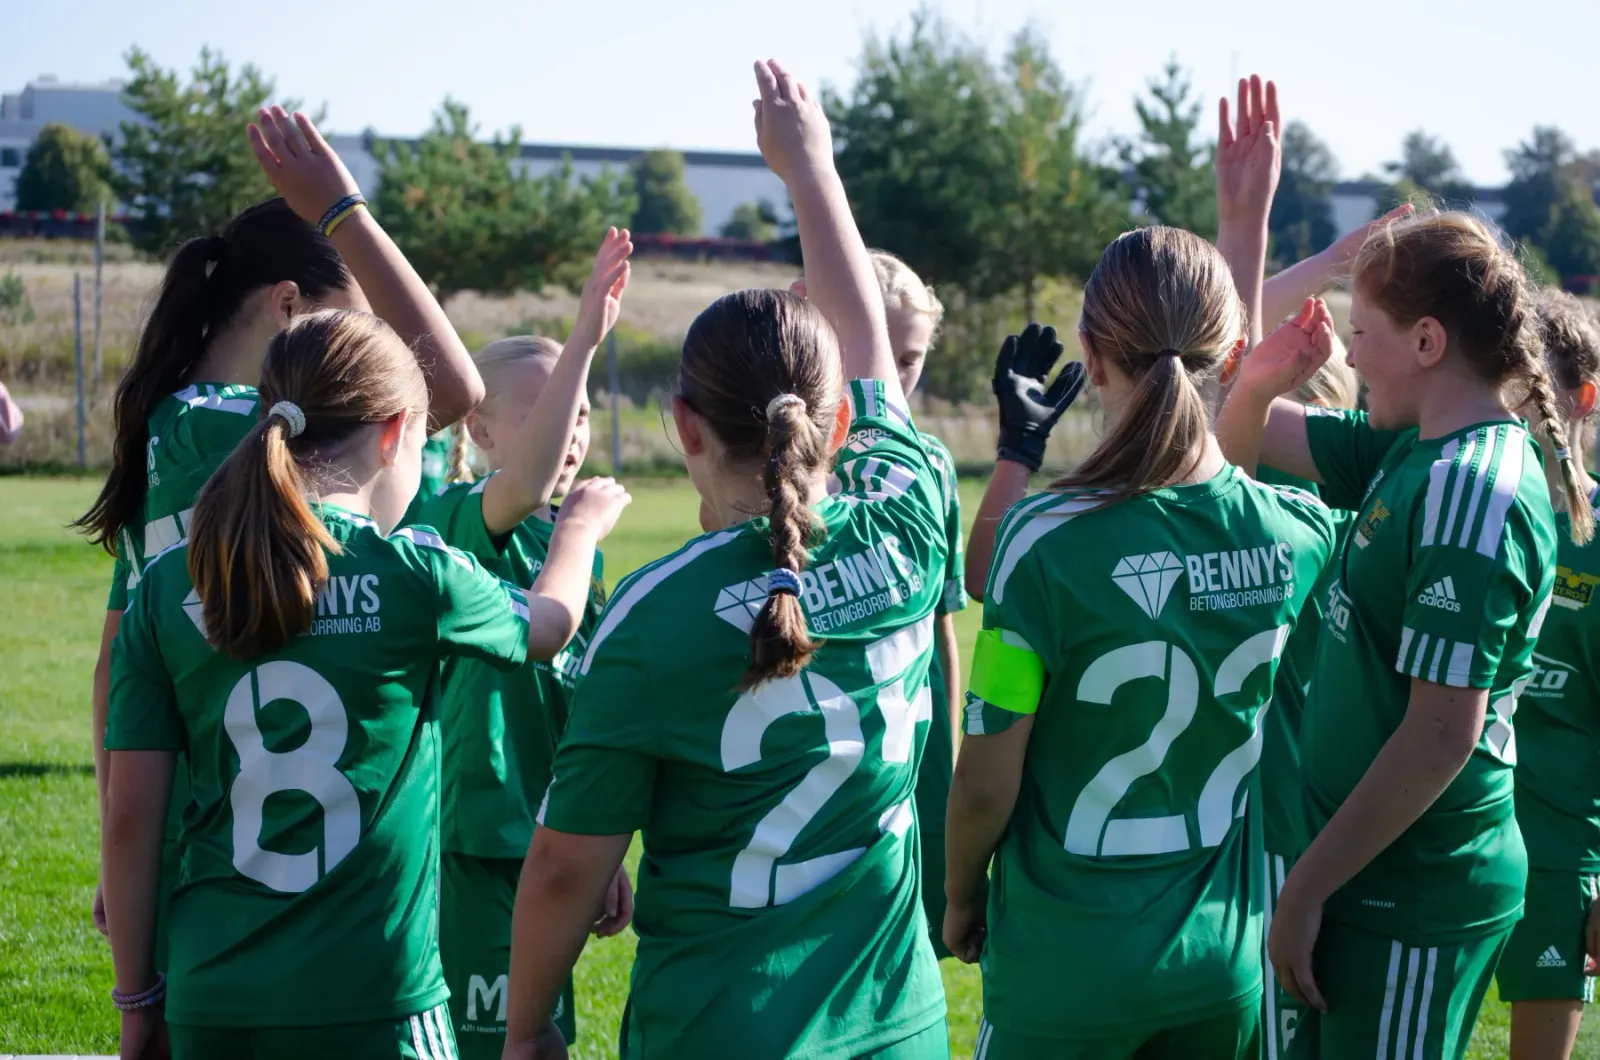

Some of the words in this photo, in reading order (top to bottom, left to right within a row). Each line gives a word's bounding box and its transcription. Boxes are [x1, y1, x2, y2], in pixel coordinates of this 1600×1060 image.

[801, 532, 914, 613] BENNYS
[907, 575, 921, 594] AB
[1185, 542, 1294, 593] BENNYS
[317, 573, 380, 616] NYS
[1190, 587, 1283, 611] BETONGBORRNING
[1284, 583, 1295, 598] AB
[1418, 593, 1461, 612] adidas
[364, 616, 381, 632] AB
[1063, 623, 1291, 857] 22
[224, 660, 361, 893] 8
[1536, 958, 1567, 967] adidas
